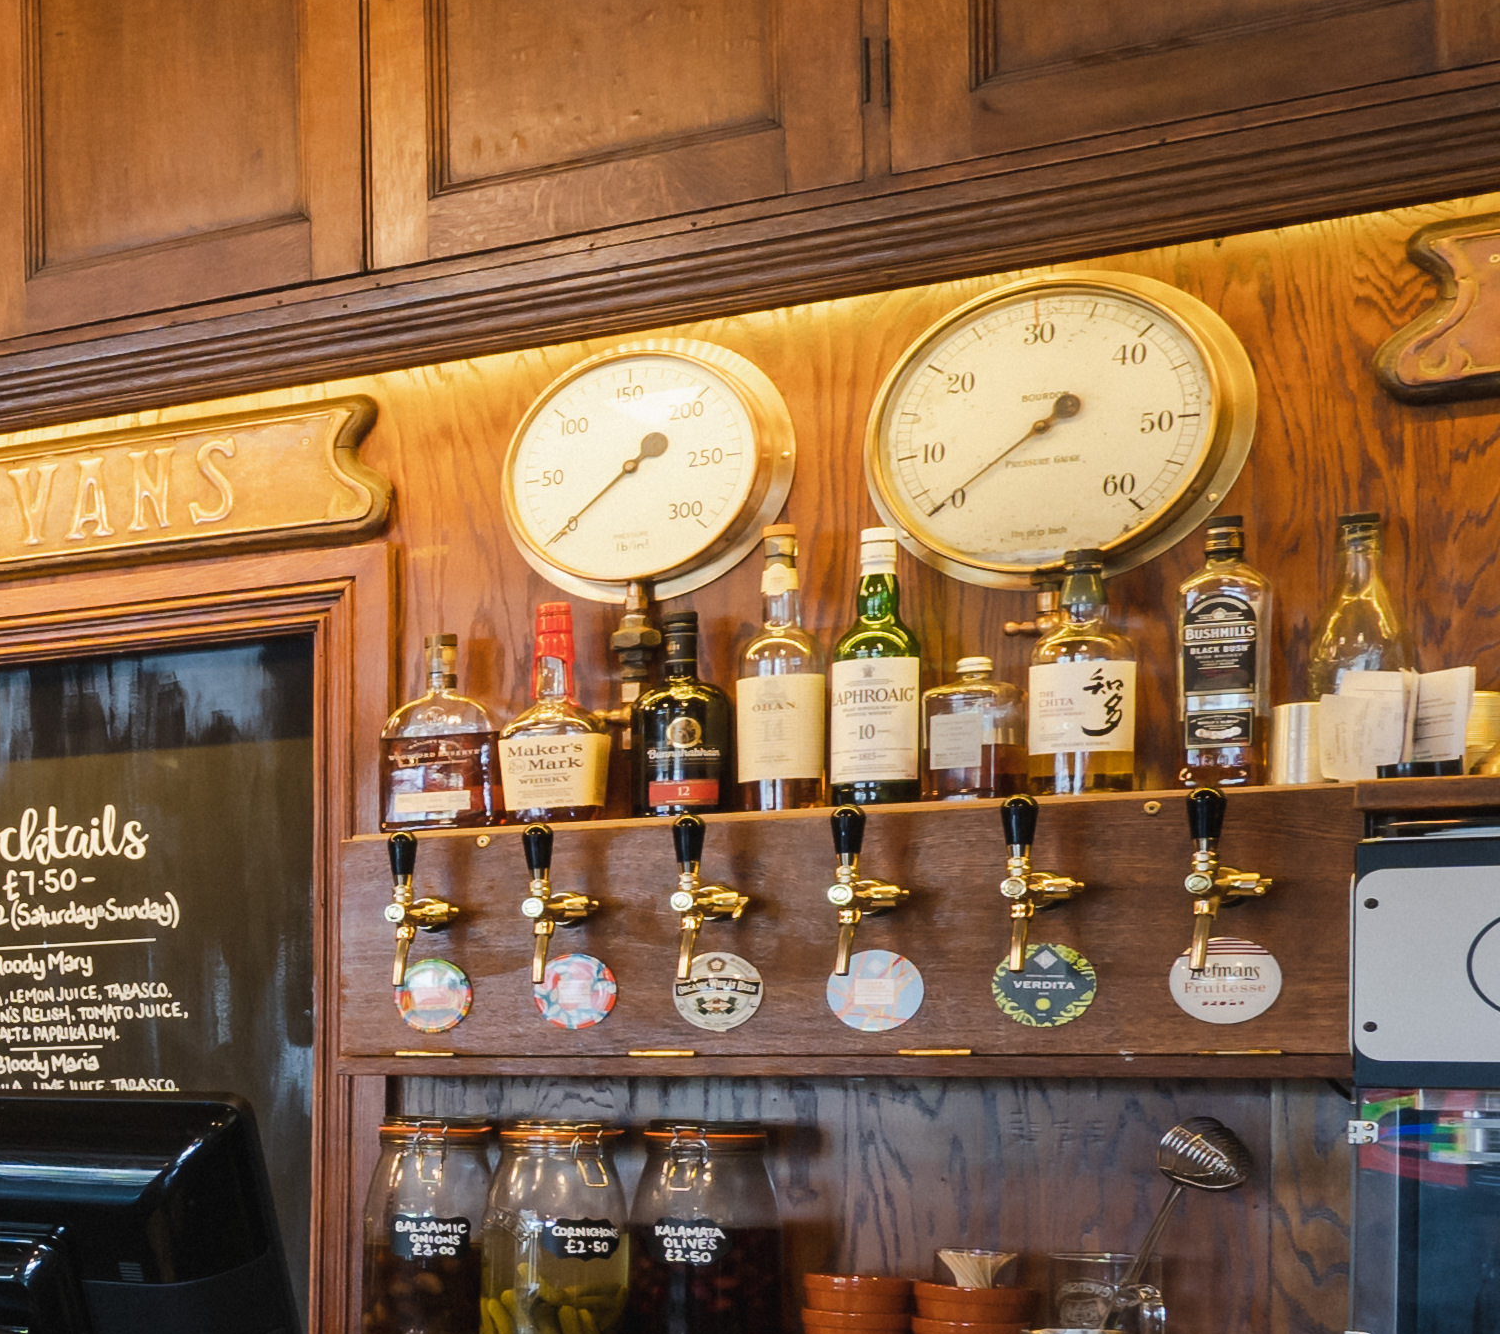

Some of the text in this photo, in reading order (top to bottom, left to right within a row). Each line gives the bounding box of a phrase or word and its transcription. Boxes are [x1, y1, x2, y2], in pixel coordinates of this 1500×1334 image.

[1023, 321, 1056, 345] 30
[1111, 342, 1148, 366] 40
[946, 371, 976, 395] 20
[616, 384, 645, 404] 150
[668, 400, 704, 421] 200
[561, 417, 589, 436] 100
[1140, 409, 1174, 434] 50
[687, 447, 723, 468] 250
[922, 441, 946, 464] 10
[540, 469, 565, 487] 50
[1102, 472, 1136, 497] 60
[951, 487, 966, 510] 0
[668, 500, 704, 521] 300
[568, 515, 579, 532] 0
[1184, 625, 1256, 641] BUSHMILLS
[1189, 643, 1249, 656] BLACK BUSH
[1038, 697, 1074, 709] CHITA
[858, 723, 875, 741] 10
[506, 741, 584, 758] Maker's
[527, 756, 585, 773] Mark
[518, 774, 572, 786] WHISKY
[676, 785, 691, 798] 12
[46, 950, 94, 978] Mary
[1012, 980, 1076, 990] VERDITA
[1184, 981, 1267, 995] Fruitesse
[9, 986, 55, 1005] LEMON
[76, 1003, 134, 1024] TOMATO
[135, 1001, 189, 1020] JUICE,
[32, 1024, 88, 1043] PAPRIKA
[50, 1051, 101, 1075] Maria
[395, 1220, 468, 1236] BALSAMIC
[551, 1225, 619, 1240] CORNICHONS
[654, 1225, 725, 1241] KALAMATA
[409, 1232, 461, 1246] ONIONS
[663, 1237, 718, 1251] OLIVES
